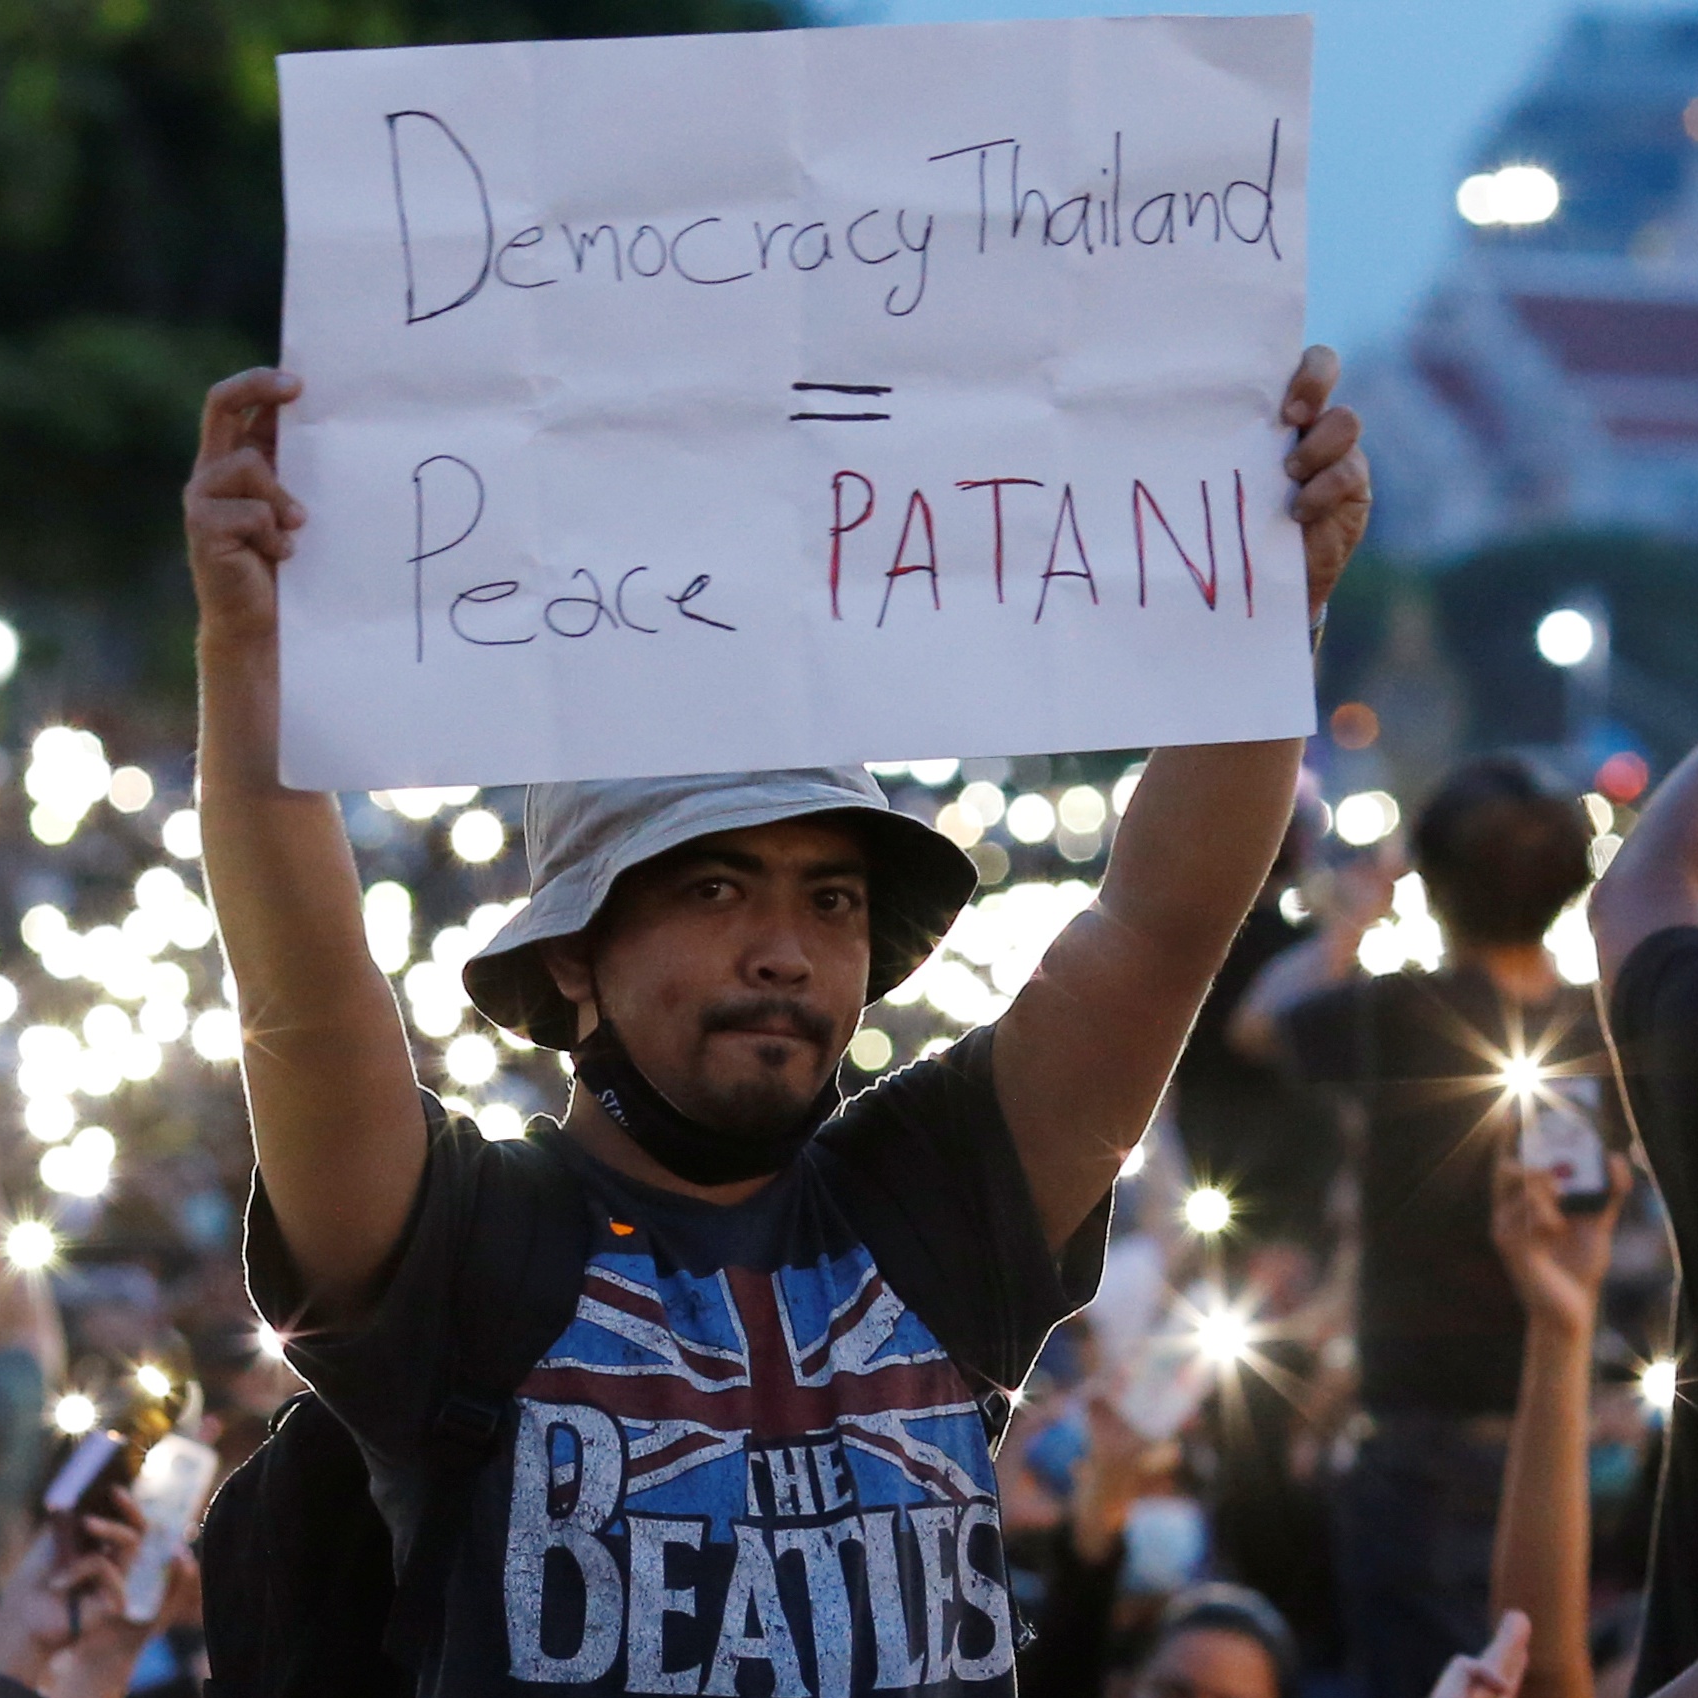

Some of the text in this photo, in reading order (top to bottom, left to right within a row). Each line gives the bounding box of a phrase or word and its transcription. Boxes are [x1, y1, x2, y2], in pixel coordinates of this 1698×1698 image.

[385, 110, 1283, 324] Democracy Thailand
[405, 454, 1256, 663] Peace PATANI
[747, 1442, 855, 1517] THE
